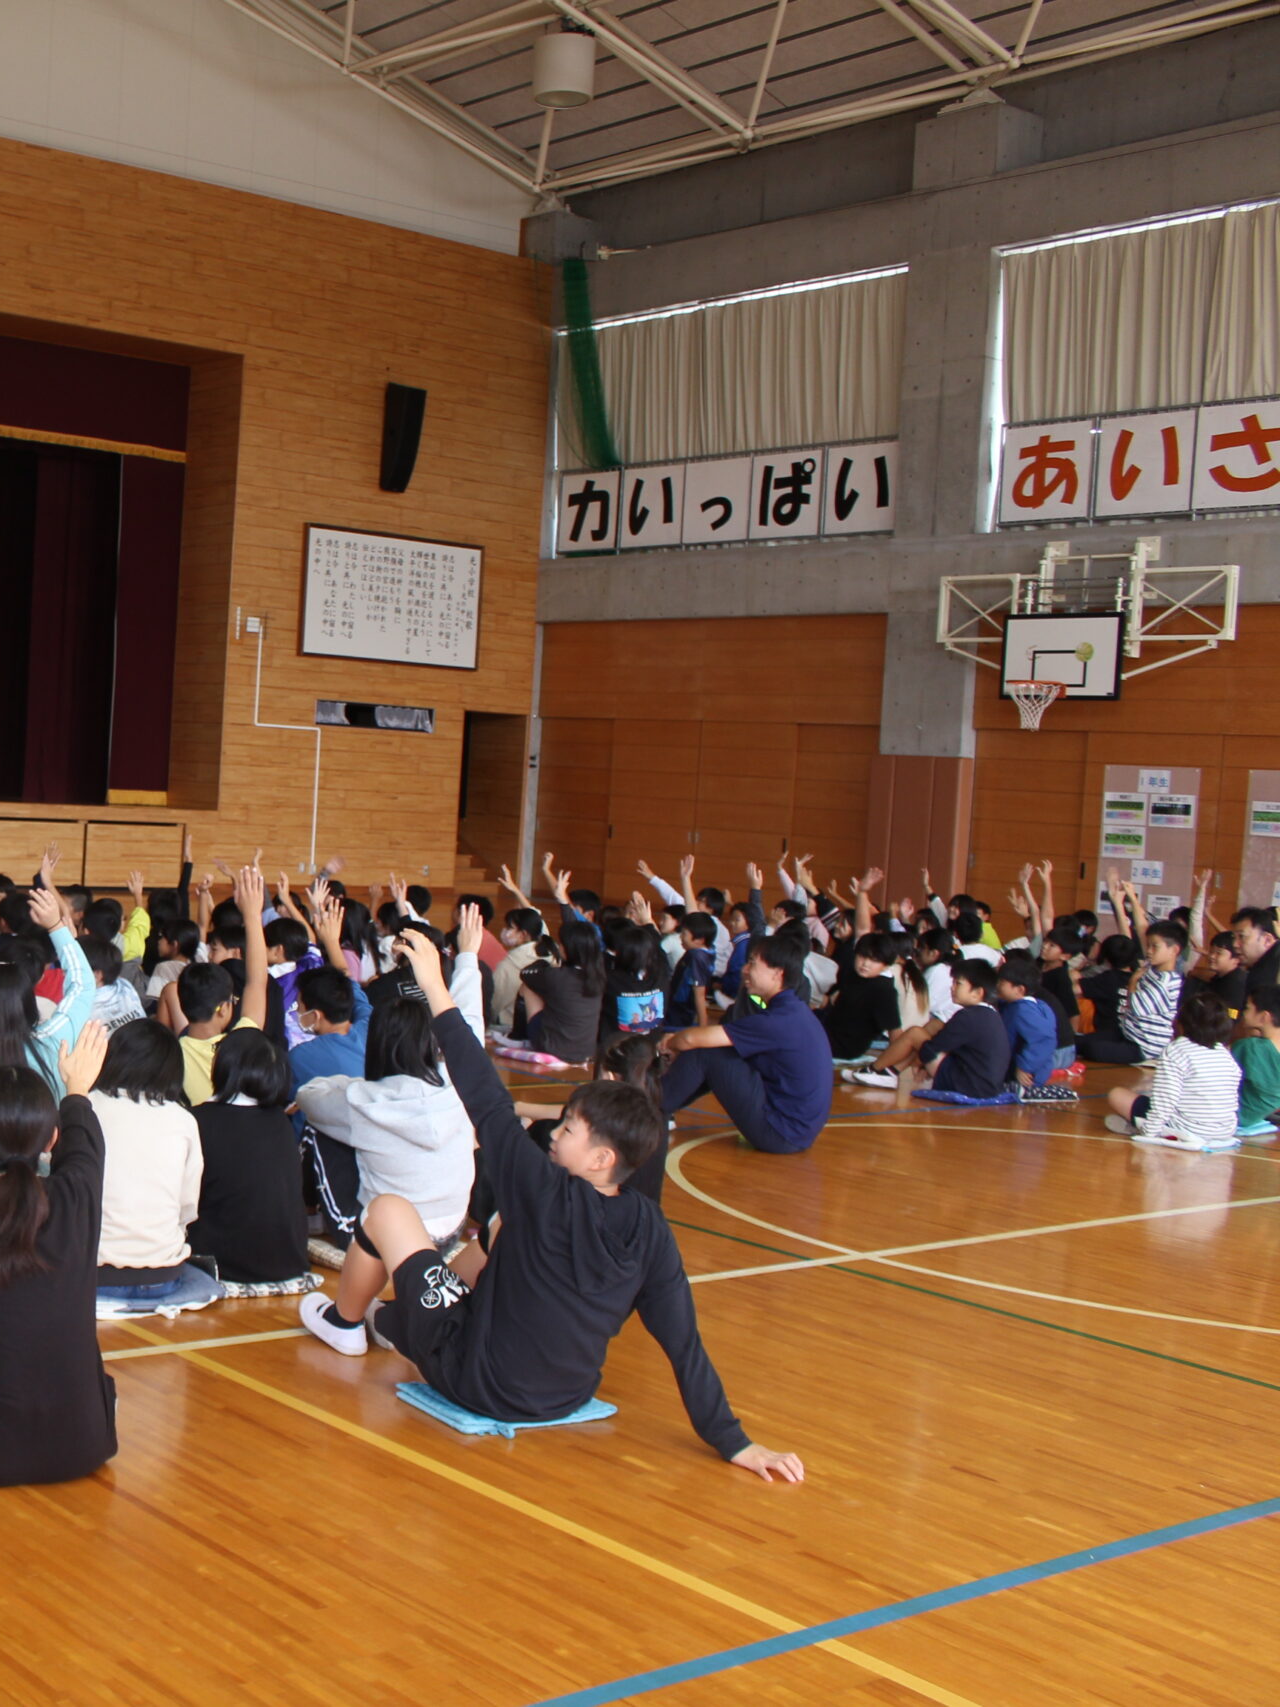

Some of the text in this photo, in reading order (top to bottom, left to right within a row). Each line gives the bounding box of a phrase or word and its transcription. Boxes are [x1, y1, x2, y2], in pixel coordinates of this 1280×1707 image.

[568, 454, 890, 542] 力いっぱい
[1013, 414, 1280, 508] あいさ
